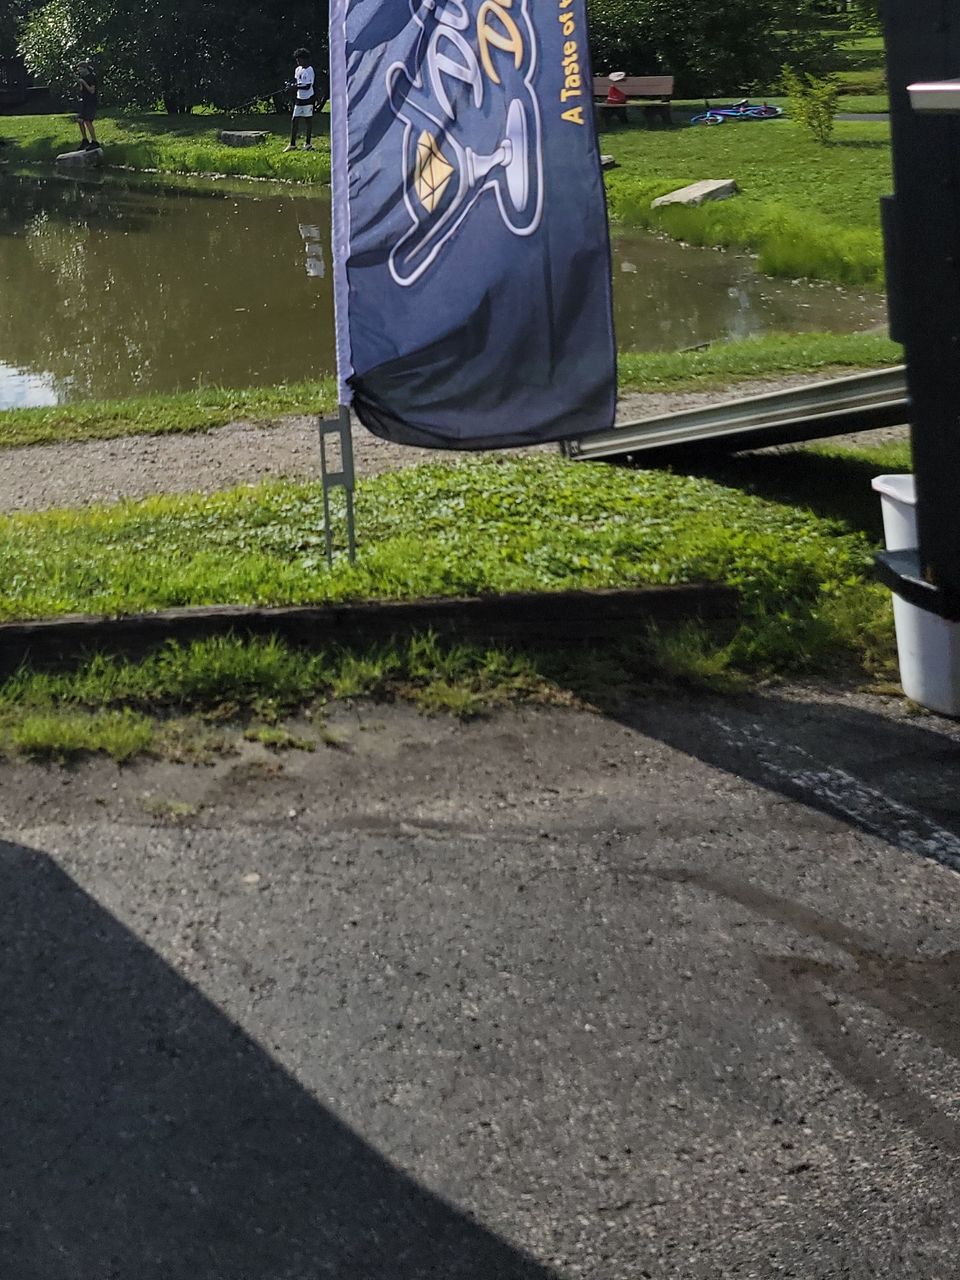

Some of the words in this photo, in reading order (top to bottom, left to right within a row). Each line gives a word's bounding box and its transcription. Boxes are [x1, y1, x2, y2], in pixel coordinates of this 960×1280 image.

[560, 12, 576, 37] of
[560, 41, 584, 102] Taste
[561, 106, 585, 125] A
